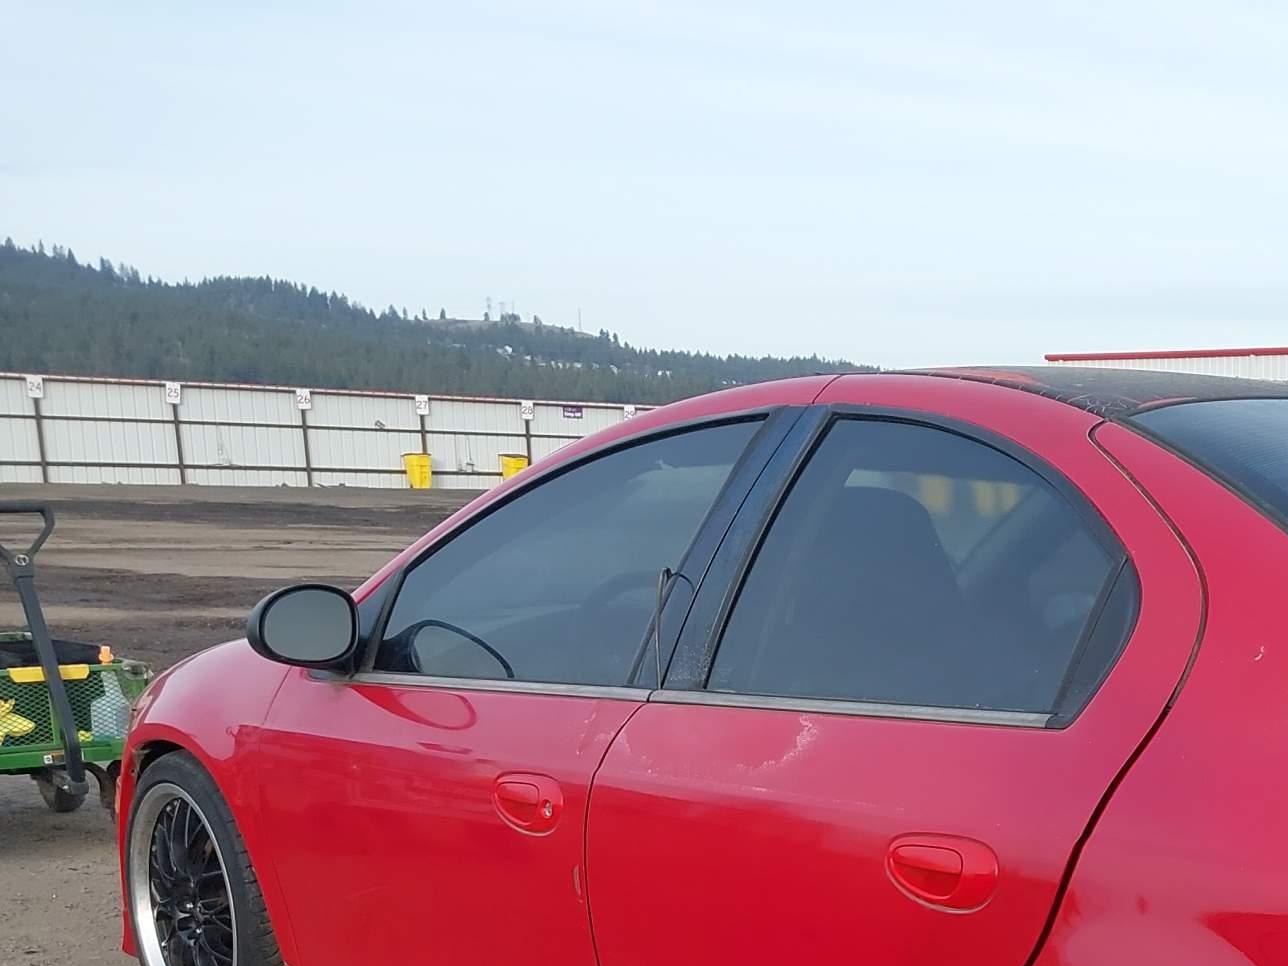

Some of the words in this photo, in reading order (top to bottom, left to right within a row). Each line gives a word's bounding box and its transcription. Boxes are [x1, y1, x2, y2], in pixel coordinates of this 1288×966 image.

[29, 382, 41, 391] 24
[168, 387, 179, 397] 25
[298, 394, 309, 403] 26
[417, 400, 428, 409] 27
[521, 405, 533, 414] 28
